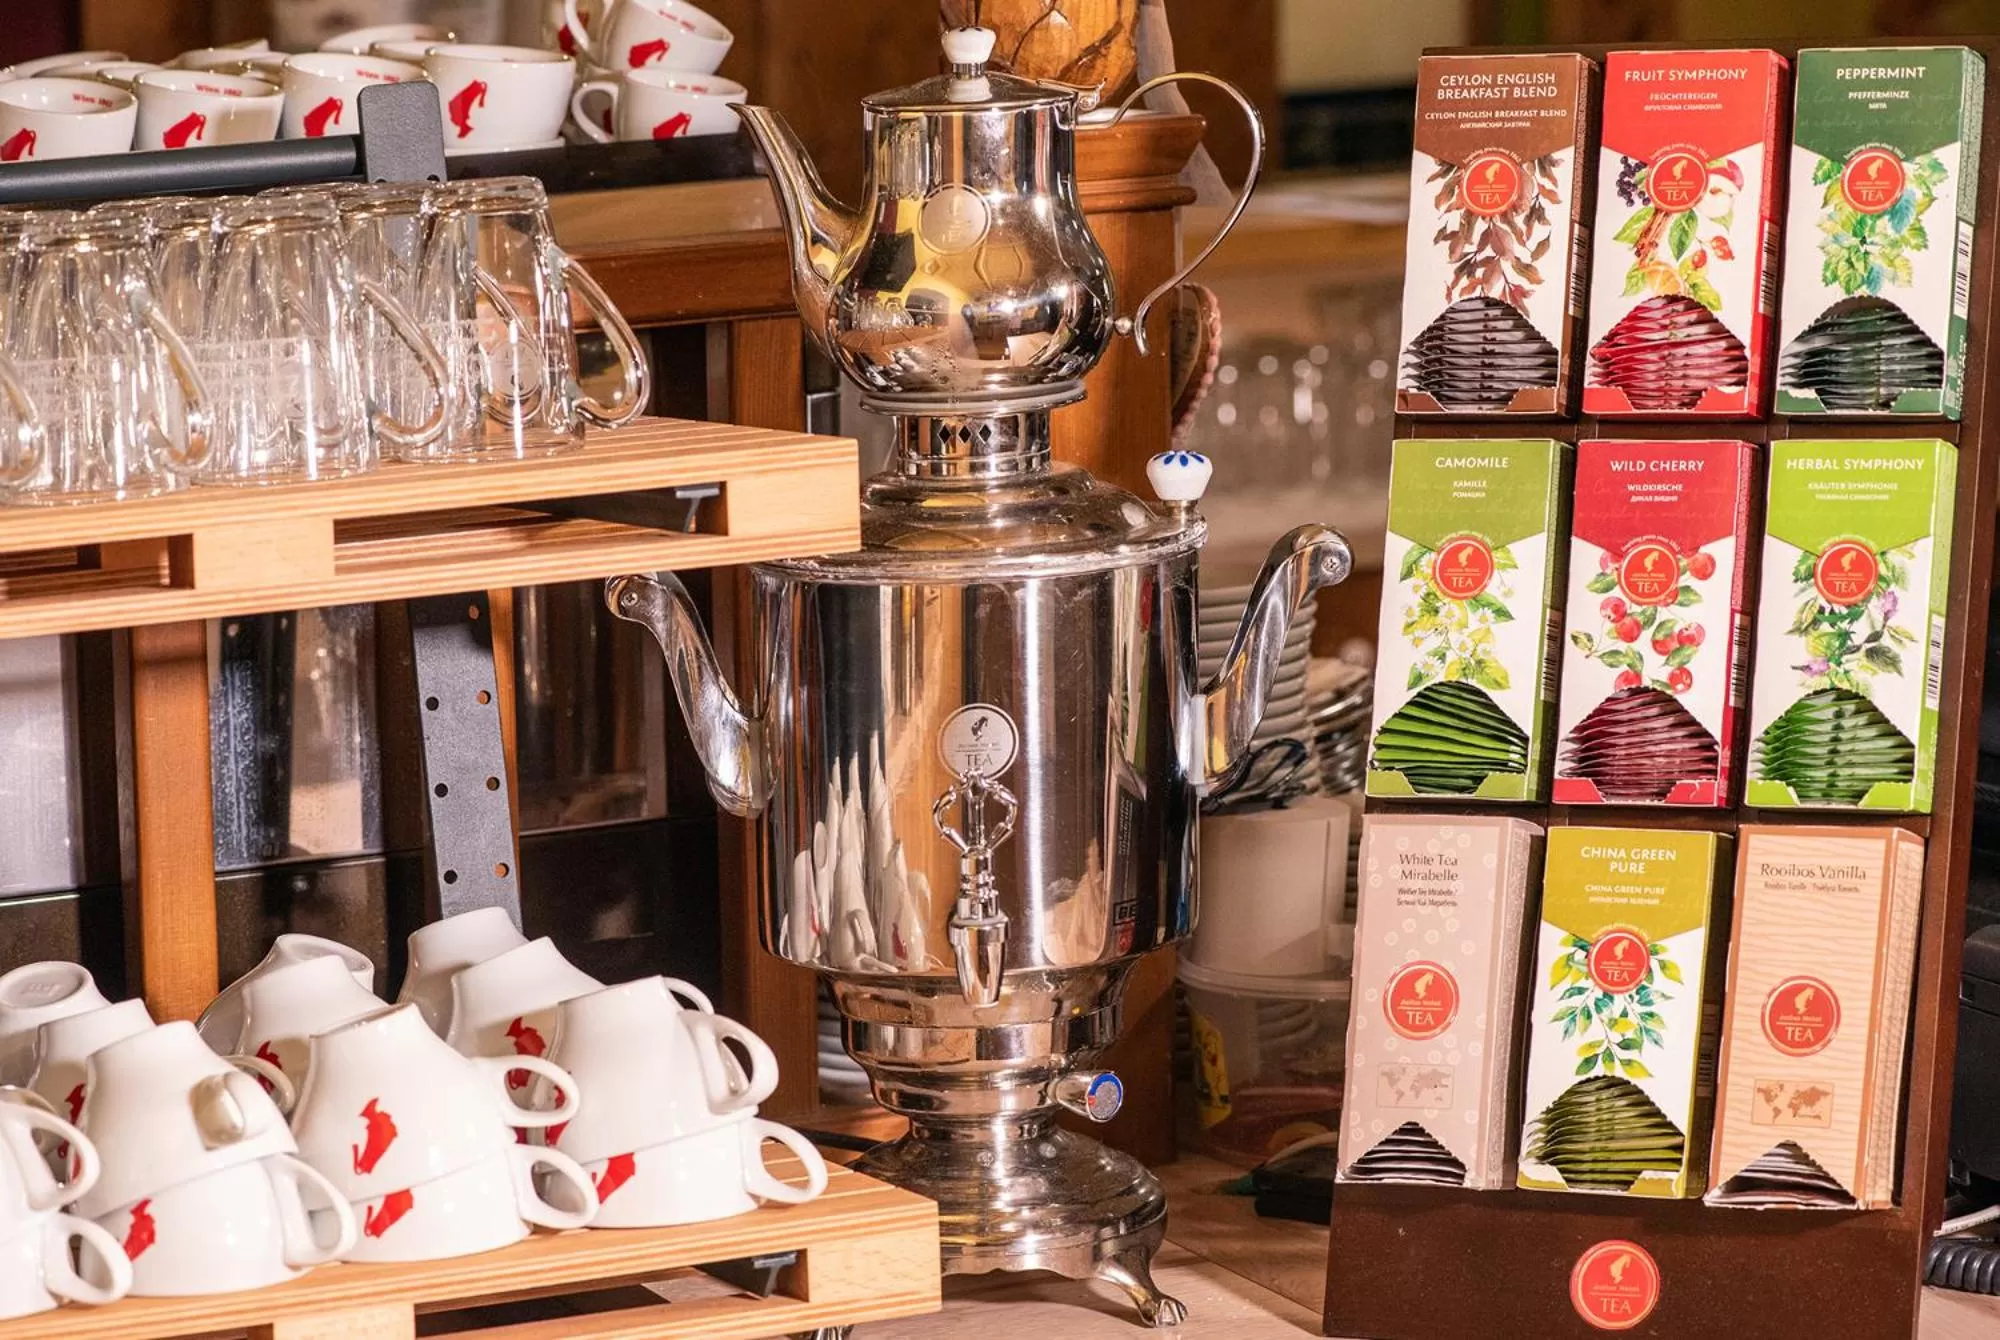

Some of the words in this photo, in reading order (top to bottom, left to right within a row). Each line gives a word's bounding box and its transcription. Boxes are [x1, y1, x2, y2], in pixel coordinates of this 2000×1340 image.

[1624, 69, 1665, 82] FRUIT
[1668, 68, 1748, 81] SYMPHONY
[1836, 66, 1926, 80] PEPPERMINT
[1440, 74, 1492, 87] CEYLON
[1497, 72, 1556, 85] ENGLISH
[1437, 87, 1509, 100] BREAKFAST
[1513, 86, 1557, 98] BLEND
[1425, 111, 1456, 120] CEYLON
[1458, 110, 1494, 119] ENGLISH
[1495, 109, 1538, 118] BREAKFAST
[1540, 109, 1568, 117] BLEND
[1479, 193, 1501, 204] TEA
[1666, 190, 1689, 201] TEA
[1860, 190, 1885, 201] TEA
[1436, 456, 1510, 469] CAMOMILE
[1610, 460, 1646, 472] WILD
[1650, 460, 1705, 472] CHERRY
[1787, 458, 1840, 470] HERBAL
[1844, 458, 1925, 470] SYMPHONY
[1453, 480, 1487, 488] KAMILLE
[1451, 576, 1473, 588] TEA
[1637, 582, 1660, 593] TEA
[1833, 581, 1857, 593] TEA
[965, 754, 993, 767] TEA
[1581, 846, 1627, 859] CHINA
[1631, 848, 1677, 861] GREEN
[1399, 853, 1434, 866] White
[1438, 854, 1458, 867] Tea
[1610, 861, 1646, 874] PURE
[1760, 863, 1816, 878] Rooibos
[1819, 866, 1867, 880] Vanilla
[1400, 869, 1459, 881] Mirabelle
[1585, 884, 1612, 893] CHINA
[1614, 885, 1643, 895] GREEN
[1644, 887, 1665, 895] PURE
[1607, 970, 1630, 982] TEA
[1406, 1011, 1435, 1025] TEA
[1785, 1027, 1814, 1041] TEA
[1600, 1298, 1632, 1314] TEA
